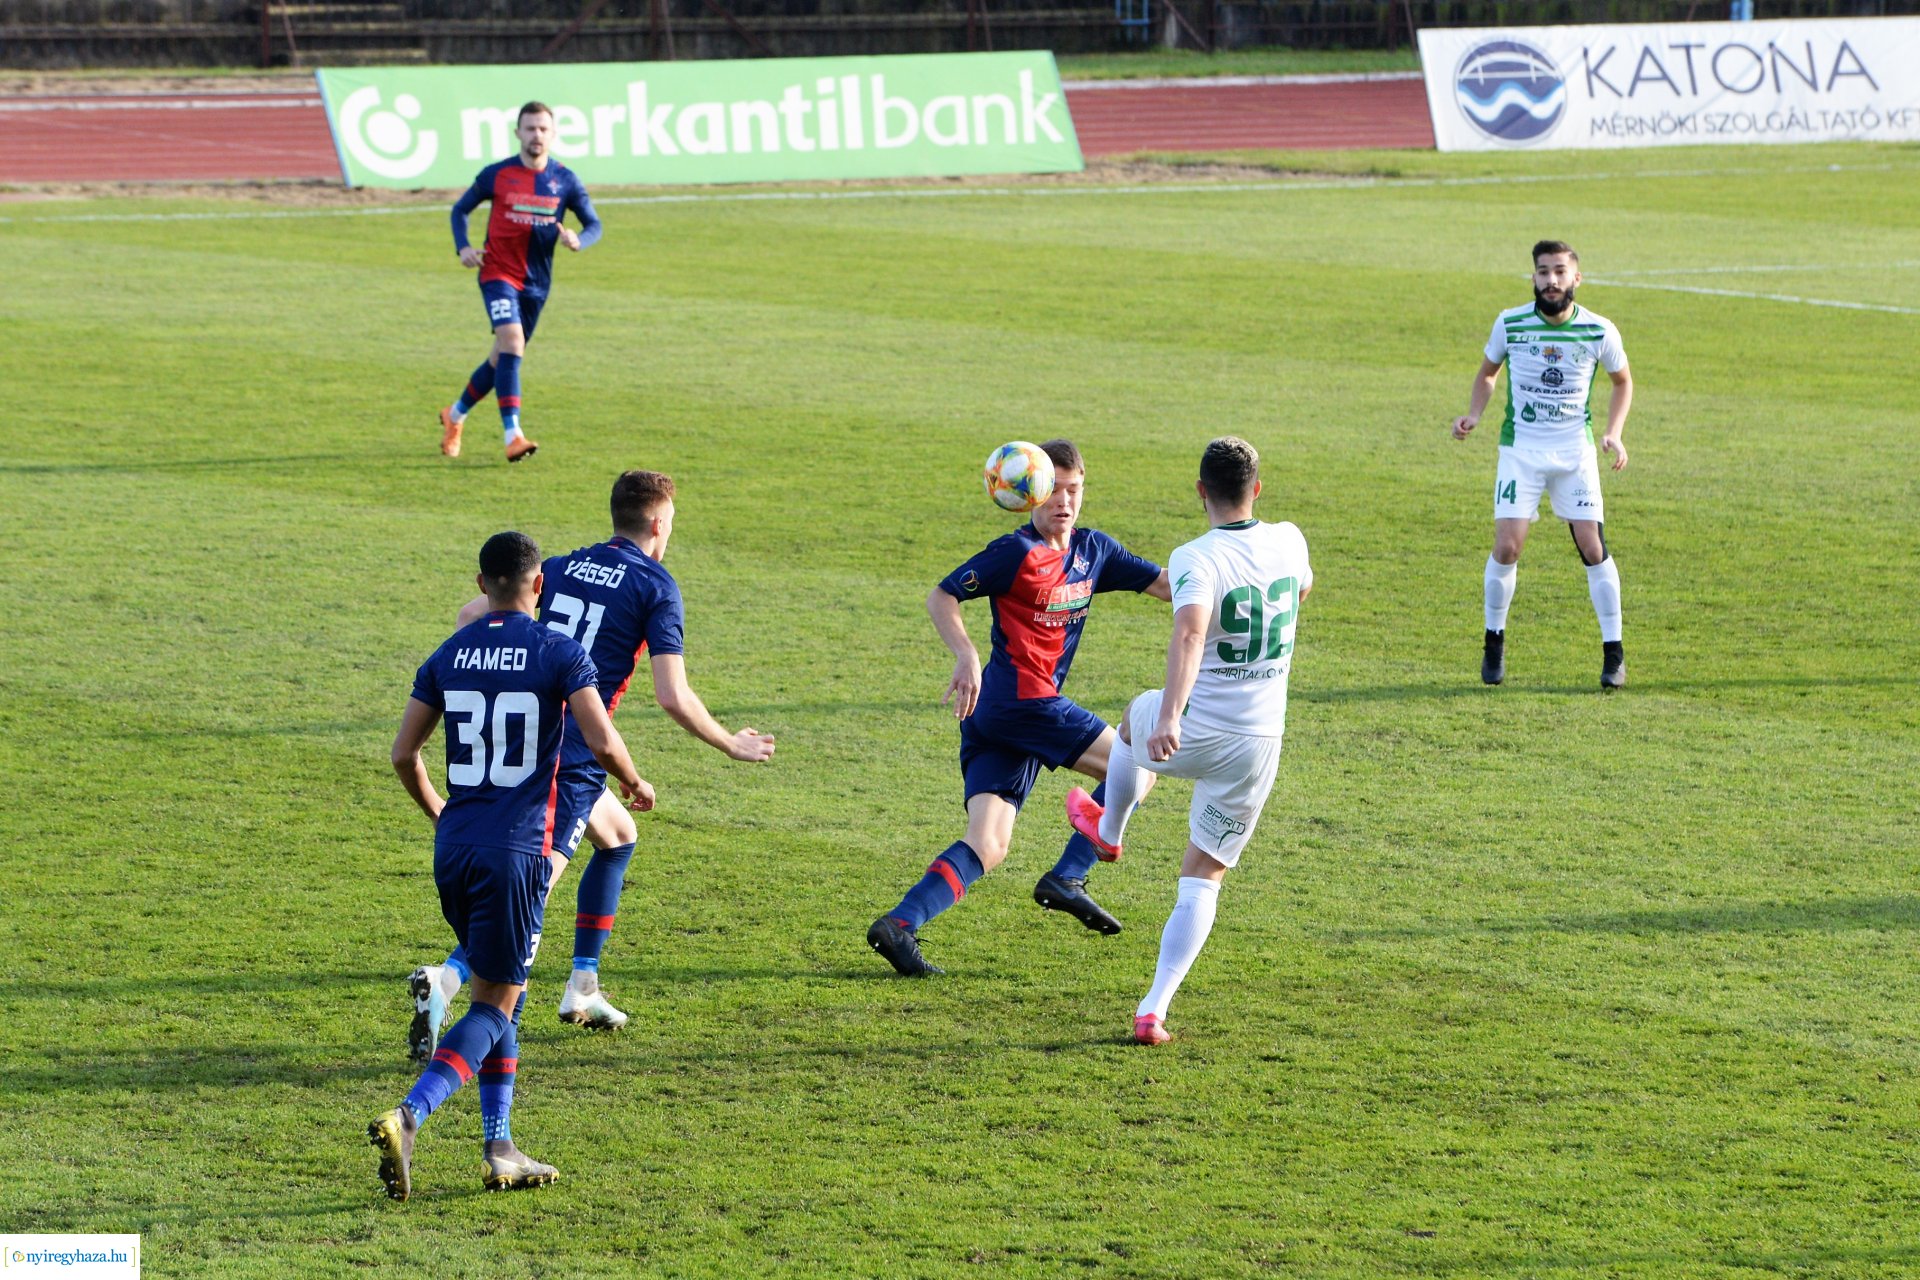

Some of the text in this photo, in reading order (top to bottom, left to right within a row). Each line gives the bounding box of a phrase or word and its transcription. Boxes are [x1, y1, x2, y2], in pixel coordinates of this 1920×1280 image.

[1583, 39, 1879, 98] KATONA
[460, 69, 1064, 161] merkantilbank
[1590, 110, 1698, 137] MÉRNÖKI
[1704, 104, 1880, 134] SZOLGÁLTATÓ
[491, 299, 512, 320] 22
[1497, 480, 1516, 504] 14
[548, 592, 606, 657] 21
[1217, 576, 1298, 663] 92
[454, 648, 527, 671] HAMED
[443, 690, 540, 788] 30
[567, 818, 587, 852] 2
[1204, 804, 1246, 832] SPIRIT
[523, 933, 541, 967] 3
